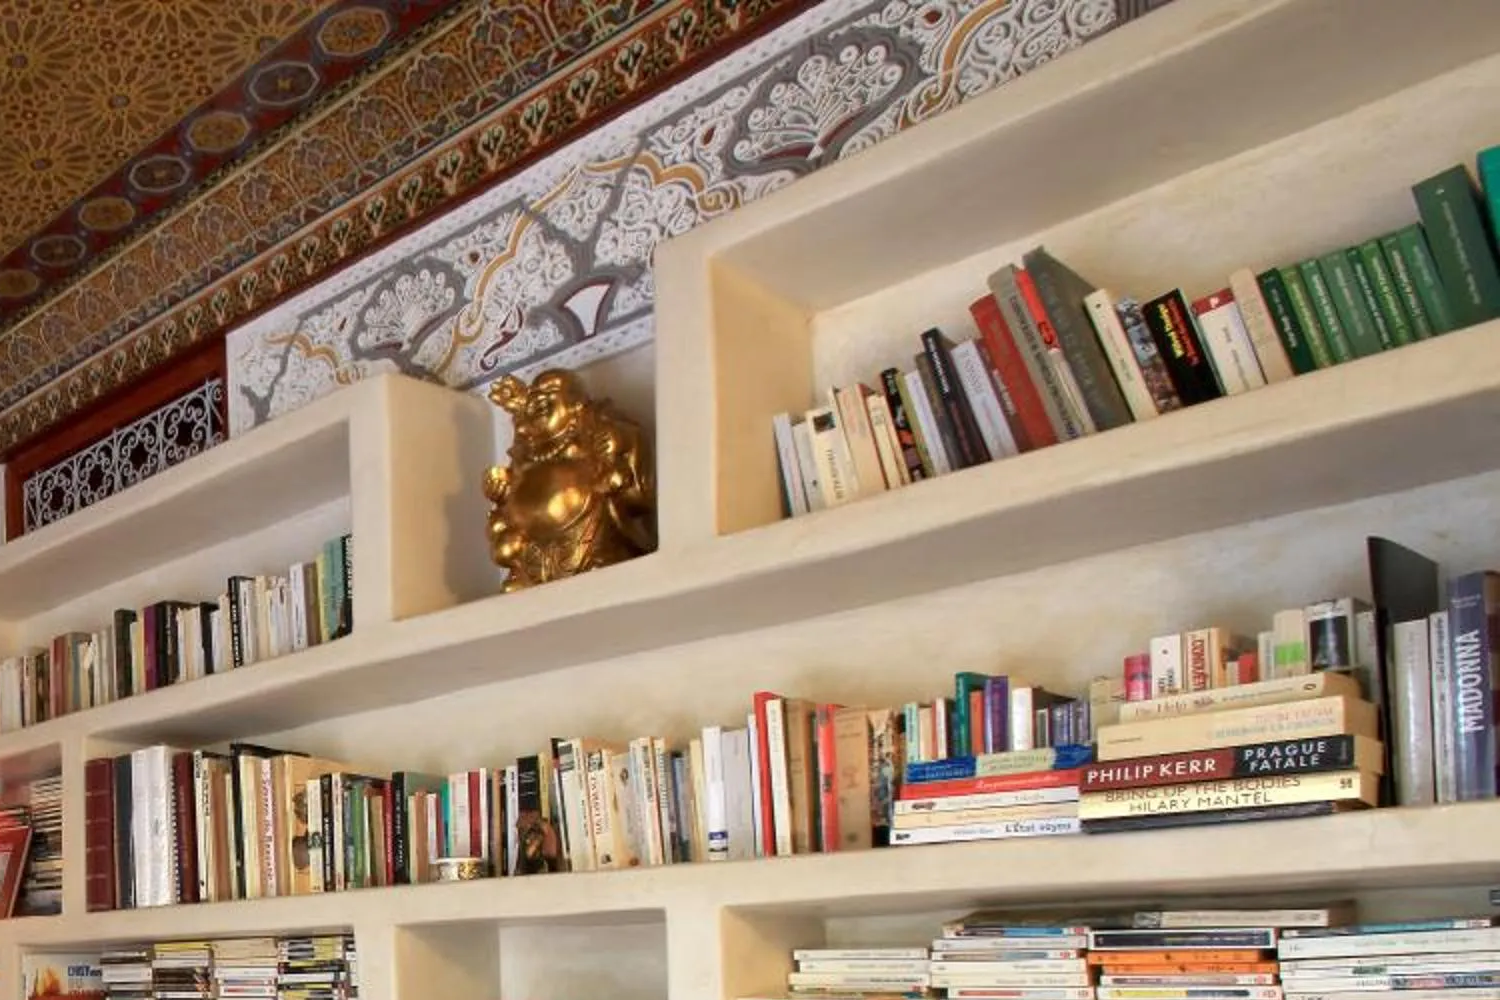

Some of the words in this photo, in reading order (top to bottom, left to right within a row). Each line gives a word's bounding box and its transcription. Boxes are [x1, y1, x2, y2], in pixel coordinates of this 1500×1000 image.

[1455, 629, 1485, 733] MADONNA
[1243, 741, 1327, 762] PRAGUE
[1250, 755, 1321, 772] FATALE
[1087, 764, 1153, 784] PHILIP
[1159, 758, 1217, 778] KERR
[1105, 786, 1158, 802] BRING
[1160, 783, 1188, 798] UP
[1193, 781, 1228, 795] THE
[1232, 776, 1301, 793] BODIES
[1129, 797, 1191, 813] HILARY
[1197, 791, 1272, 807] MANTEL
